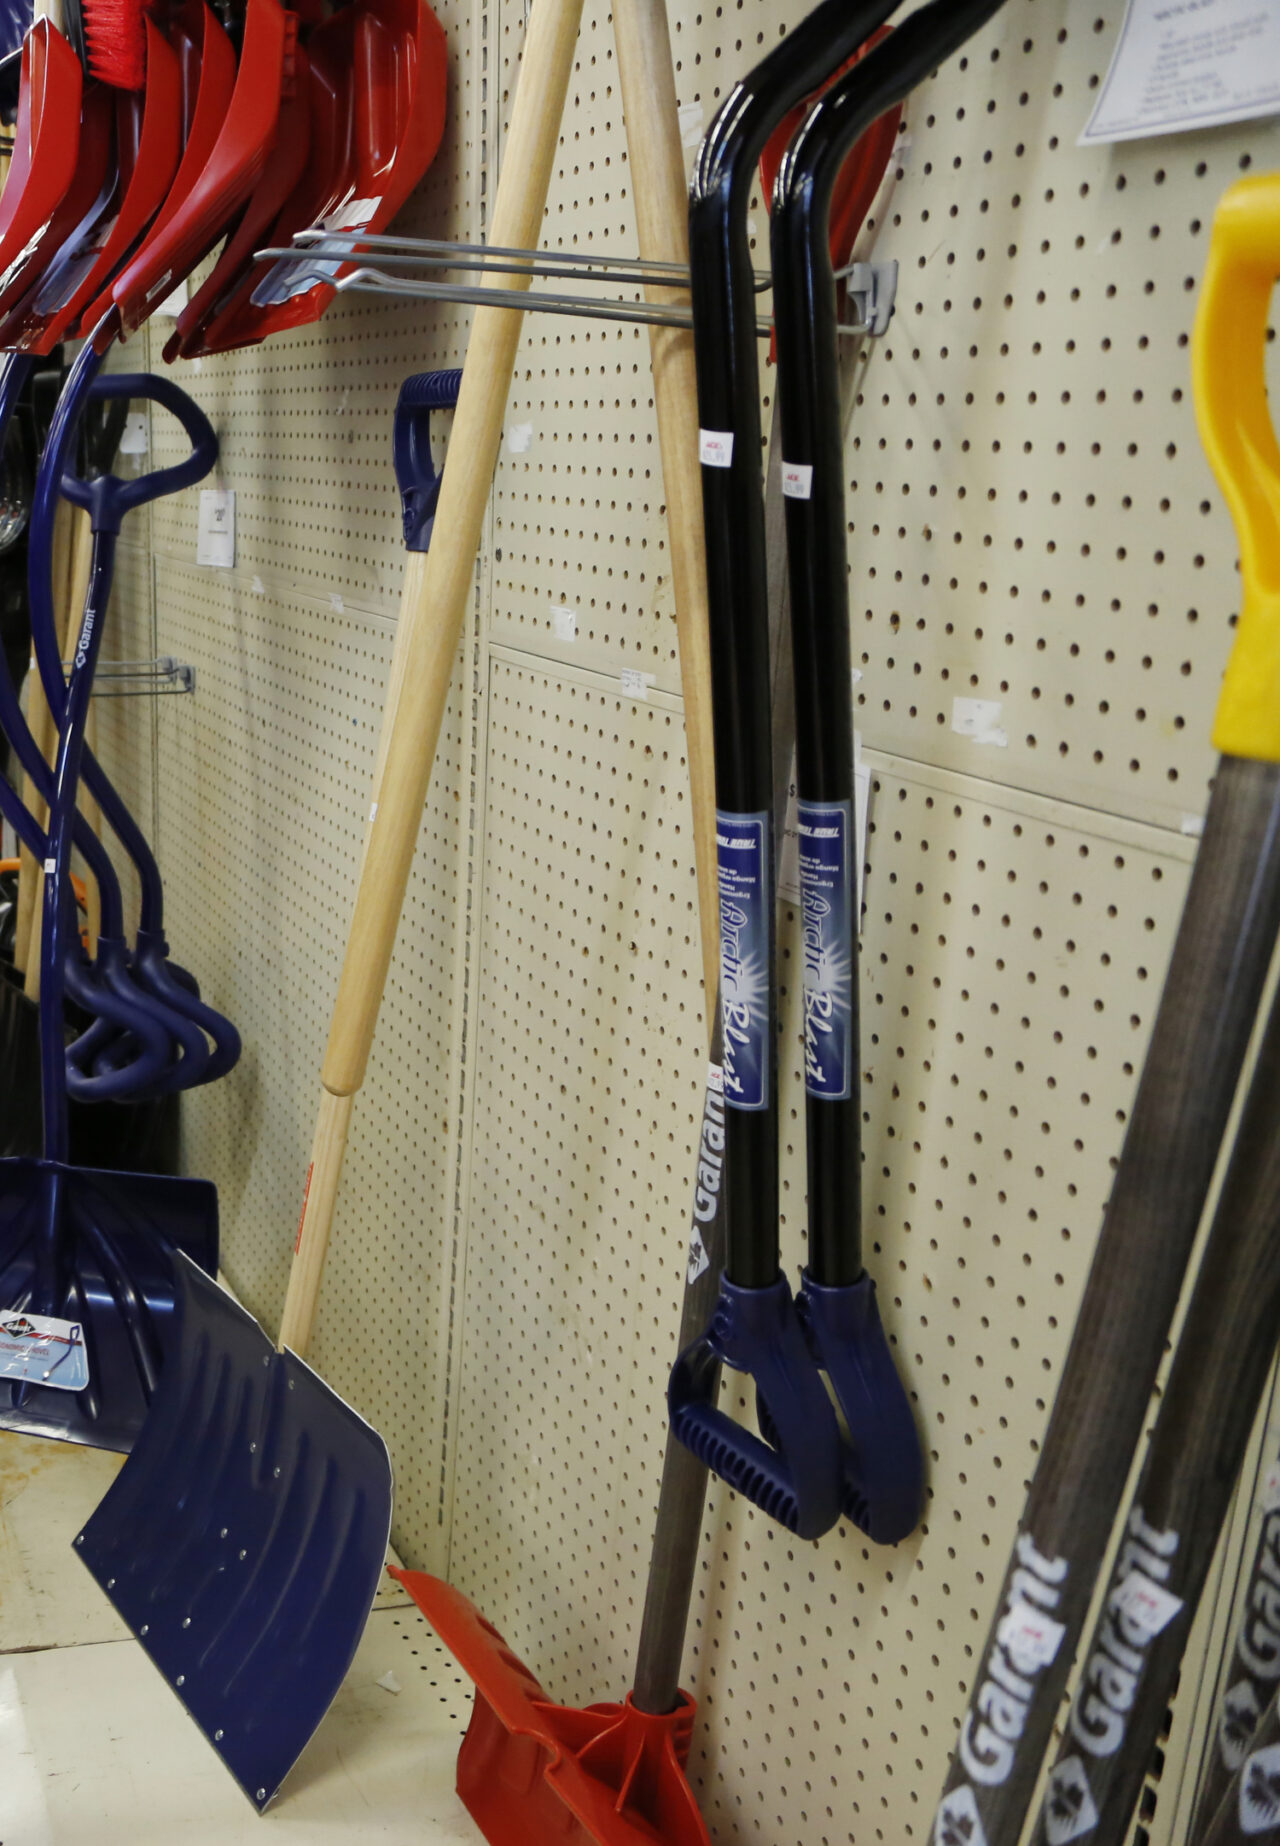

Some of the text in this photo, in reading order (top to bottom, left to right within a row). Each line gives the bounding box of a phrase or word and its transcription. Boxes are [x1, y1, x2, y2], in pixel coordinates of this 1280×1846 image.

[78, 608, 96, 650] Garant
[720, 898, 748, 992] Arctic
[803, 888, 831, 980] Arctic
[721, 999, 750, 1094] Blast
[803, 988, 833, 1083] Blast
[694, 1089, 726, 1223] Garan
